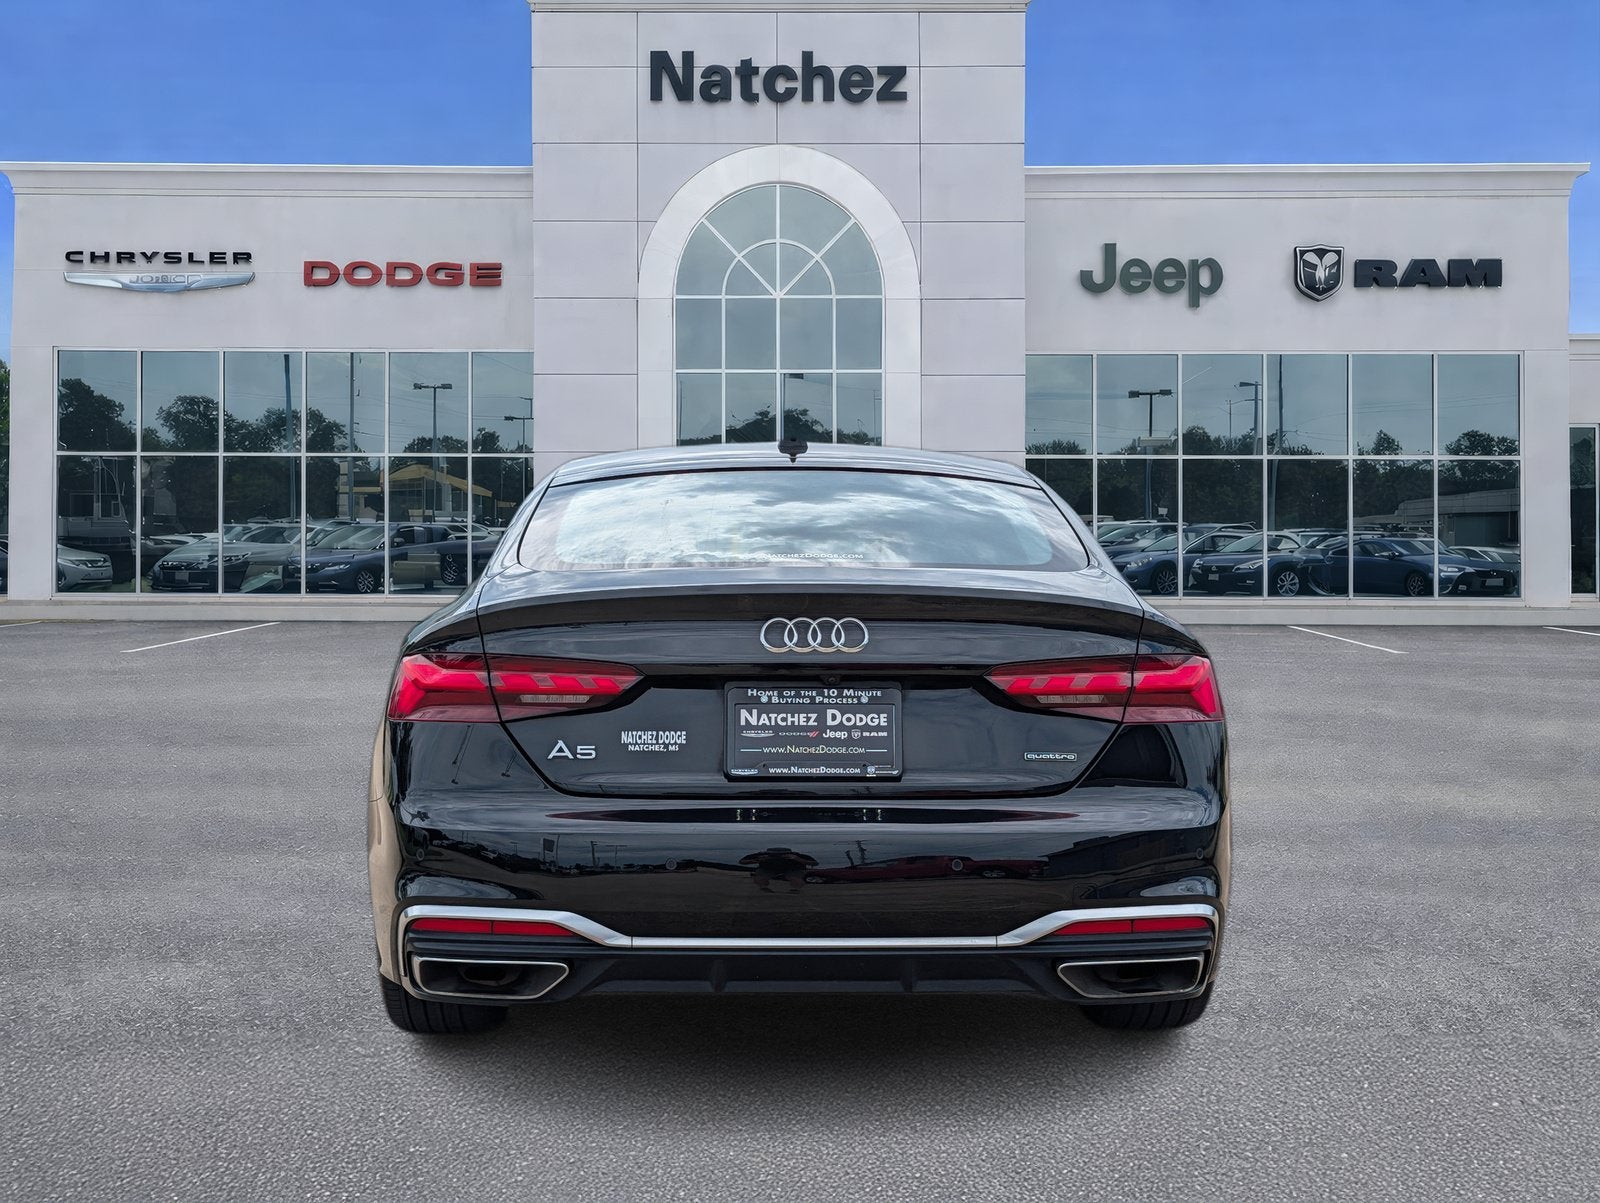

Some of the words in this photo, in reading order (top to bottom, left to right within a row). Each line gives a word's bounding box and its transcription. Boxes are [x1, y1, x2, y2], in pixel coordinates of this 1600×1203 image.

[649, 50, 908, 102] Natchez
[64, 250, 253, 264] CHRYSLER
[303, 260, 503, 287] DODGE
[1080, 243, 1224, 309] Jeep
[1353, 258, 1503, 288] RAM
[621, 731, 657, 744] NATCHEZ
[658, 731, 687, 744] DODGE
[822, 729, 848, 739] Jeep
[547, 740, 596, 760] A5
